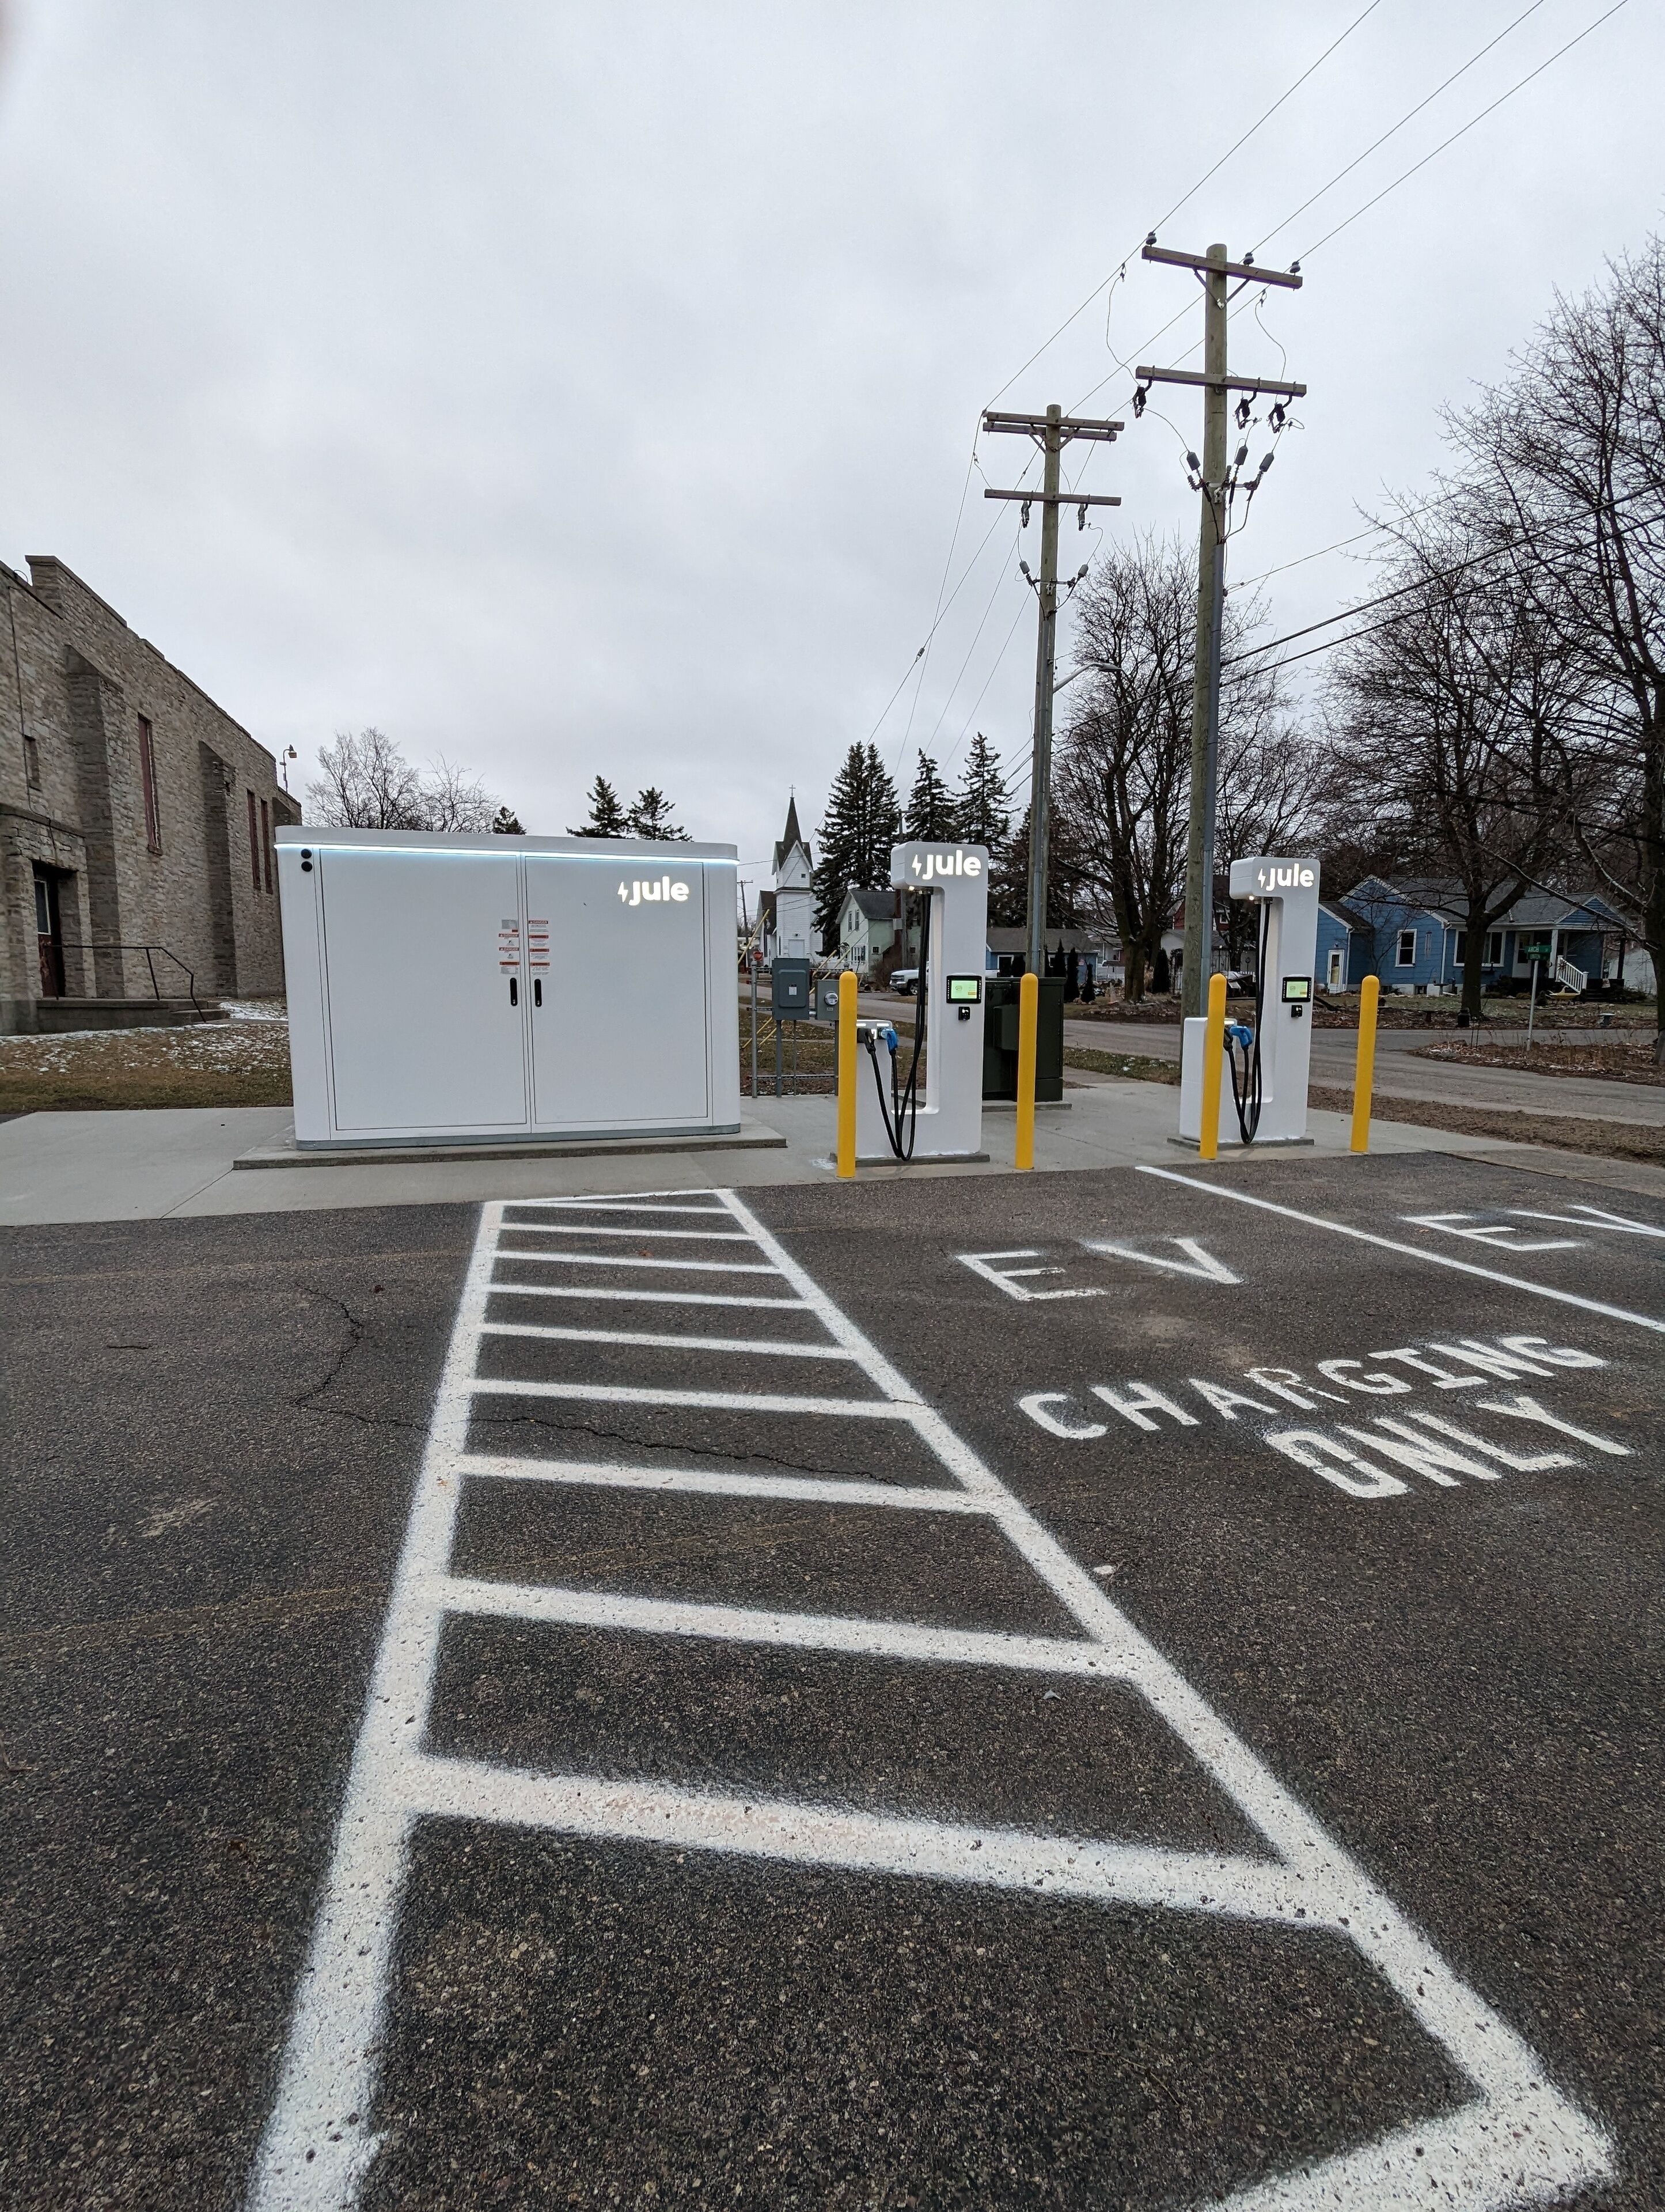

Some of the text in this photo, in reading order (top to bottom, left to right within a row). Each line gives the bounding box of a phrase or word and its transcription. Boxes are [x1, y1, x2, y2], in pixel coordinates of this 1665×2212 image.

[922, 850, 981, 880] jule
[1265, 863, 1314, 892] jule
[628, 876, 689, 906] jule
[1401, 1205, 1665, 1251] EV
[955, 1237, 1244, 1301] EV
[1019, 1336, 1608, 1440] CHARGING
[1267, 1396, 1631, 1499] ONLY
